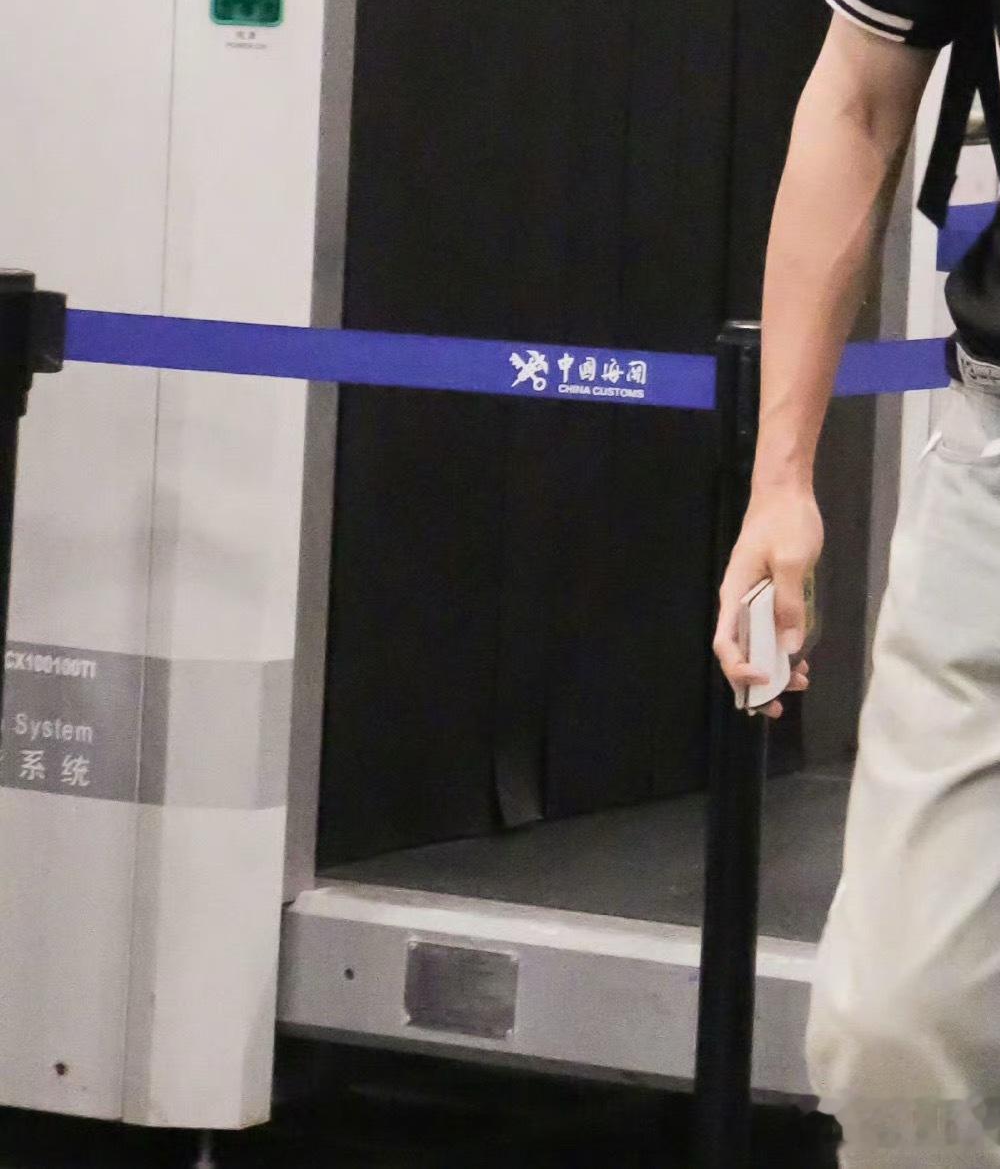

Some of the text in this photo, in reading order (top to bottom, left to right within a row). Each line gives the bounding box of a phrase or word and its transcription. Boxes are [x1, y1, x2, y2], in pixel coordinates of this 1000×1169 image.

[558, 384, 645, 399] CHINA CUSTOMS
[15, 713, 94, 745] System
[19, 749, 91, 787] 系统
